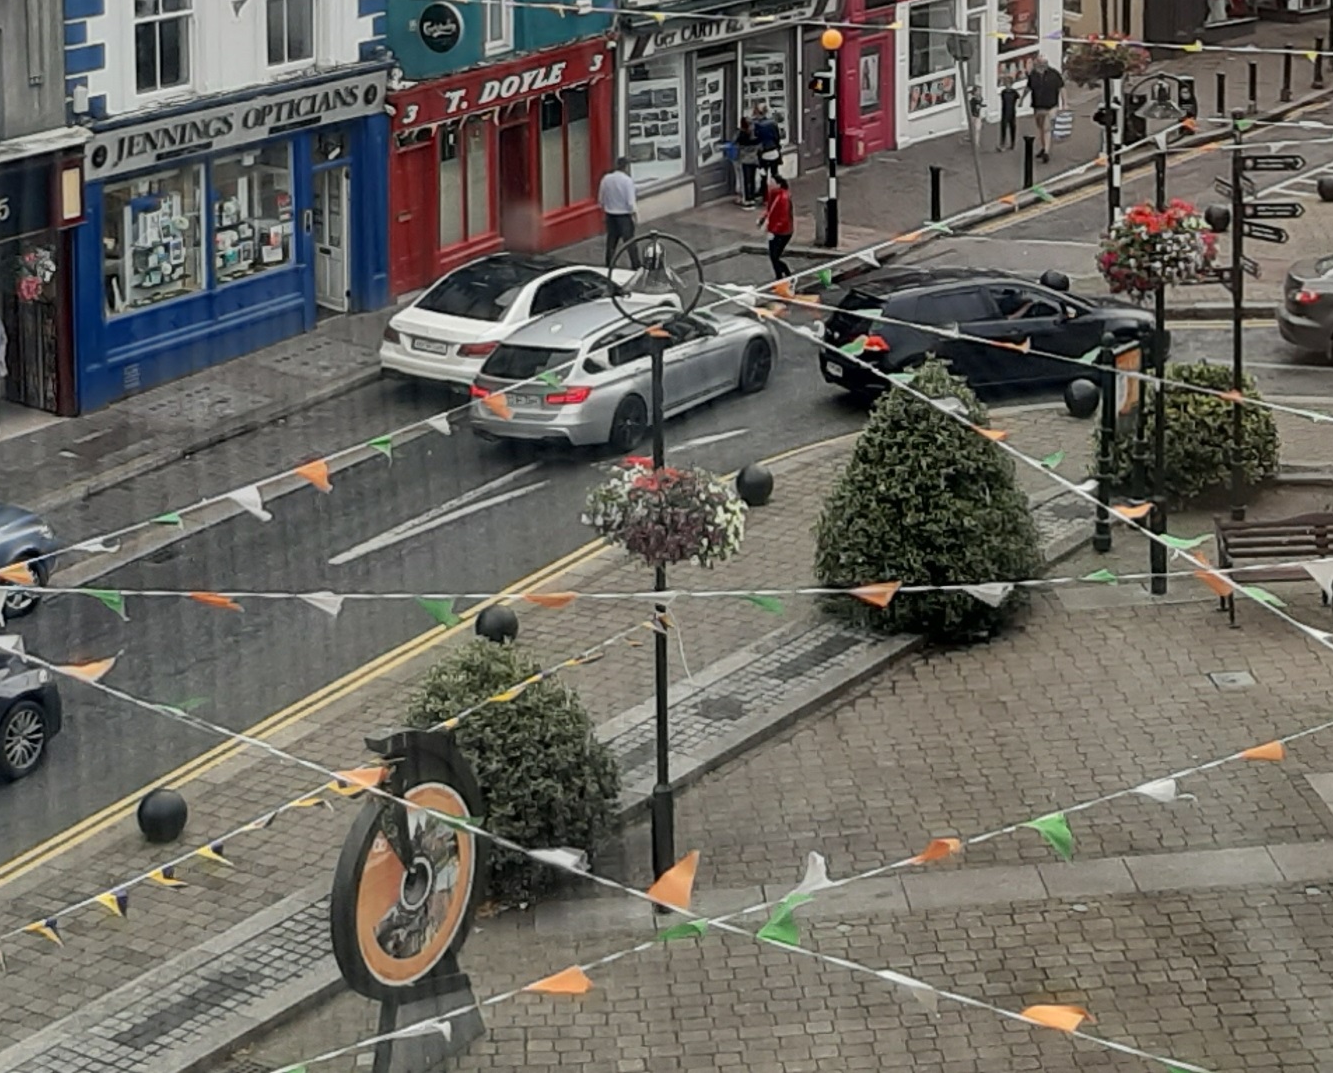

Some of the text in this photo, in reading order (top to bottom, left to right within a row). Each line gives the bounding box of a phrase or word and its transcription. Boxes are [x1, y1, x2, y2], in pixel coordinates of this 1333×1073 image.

[589, 54, 604, 72] 3
[444, 62, 567, 113] T. DOYLE
[113, 84, 359, 167] JENNINGS OPTICIANS
[402, 105, 418, 124] 3
